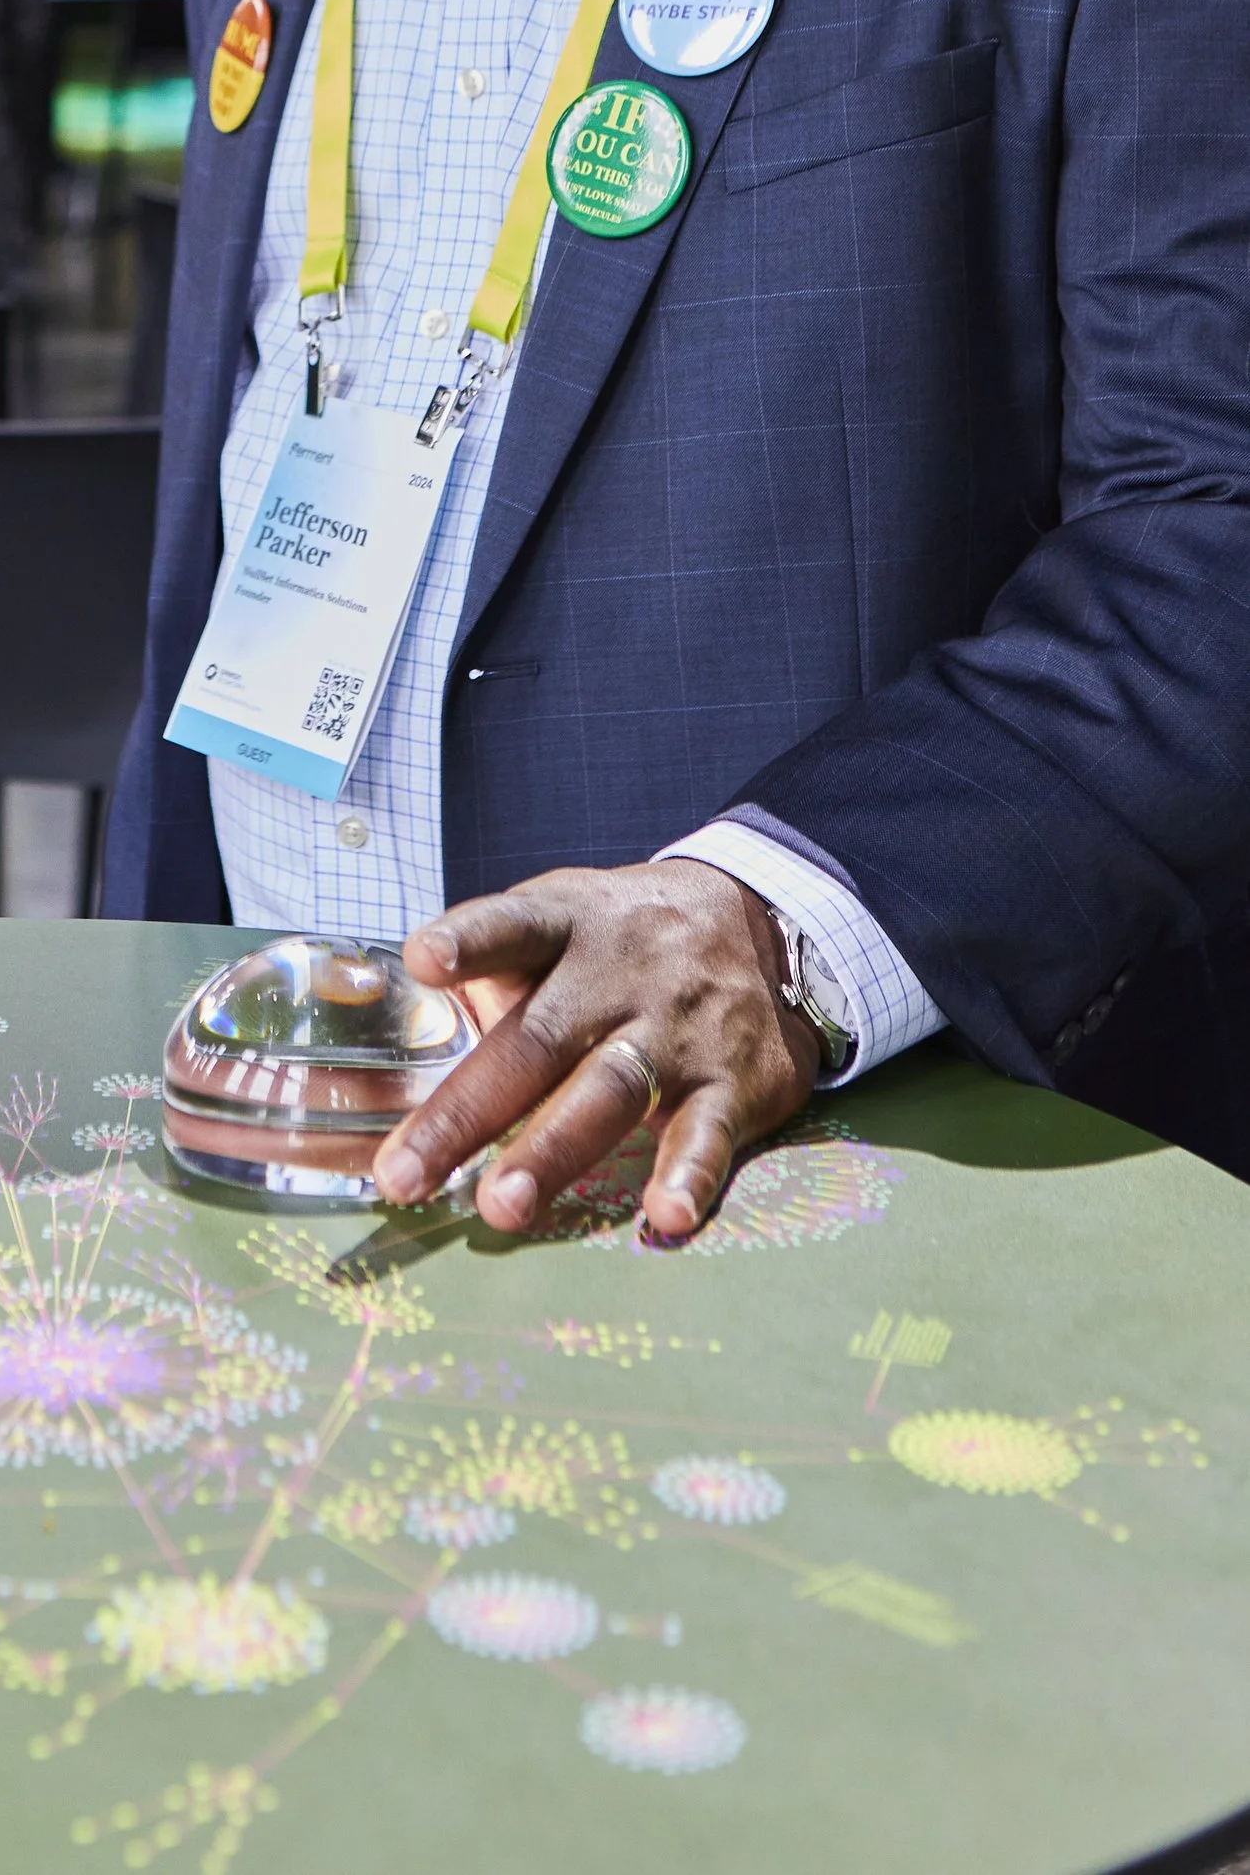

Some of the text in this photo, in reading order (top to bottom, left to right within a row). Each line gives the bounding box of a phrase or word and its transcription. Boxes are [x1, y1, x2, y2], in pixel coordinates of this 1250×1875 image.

[602, 92, 648, 135] IF
[555, 152, 592, 176] EAD
[594, 163, 633, 190] THIS,
[561, 180, 587, 197] UST
[585, 185, 615, 206] LOVE
[408, 472, 434, 491] 2024
[264, 496, 369, 547] Jefferson
[254, 525, 332, 568] Parker
[236, 743, 274, 765] GUEST
